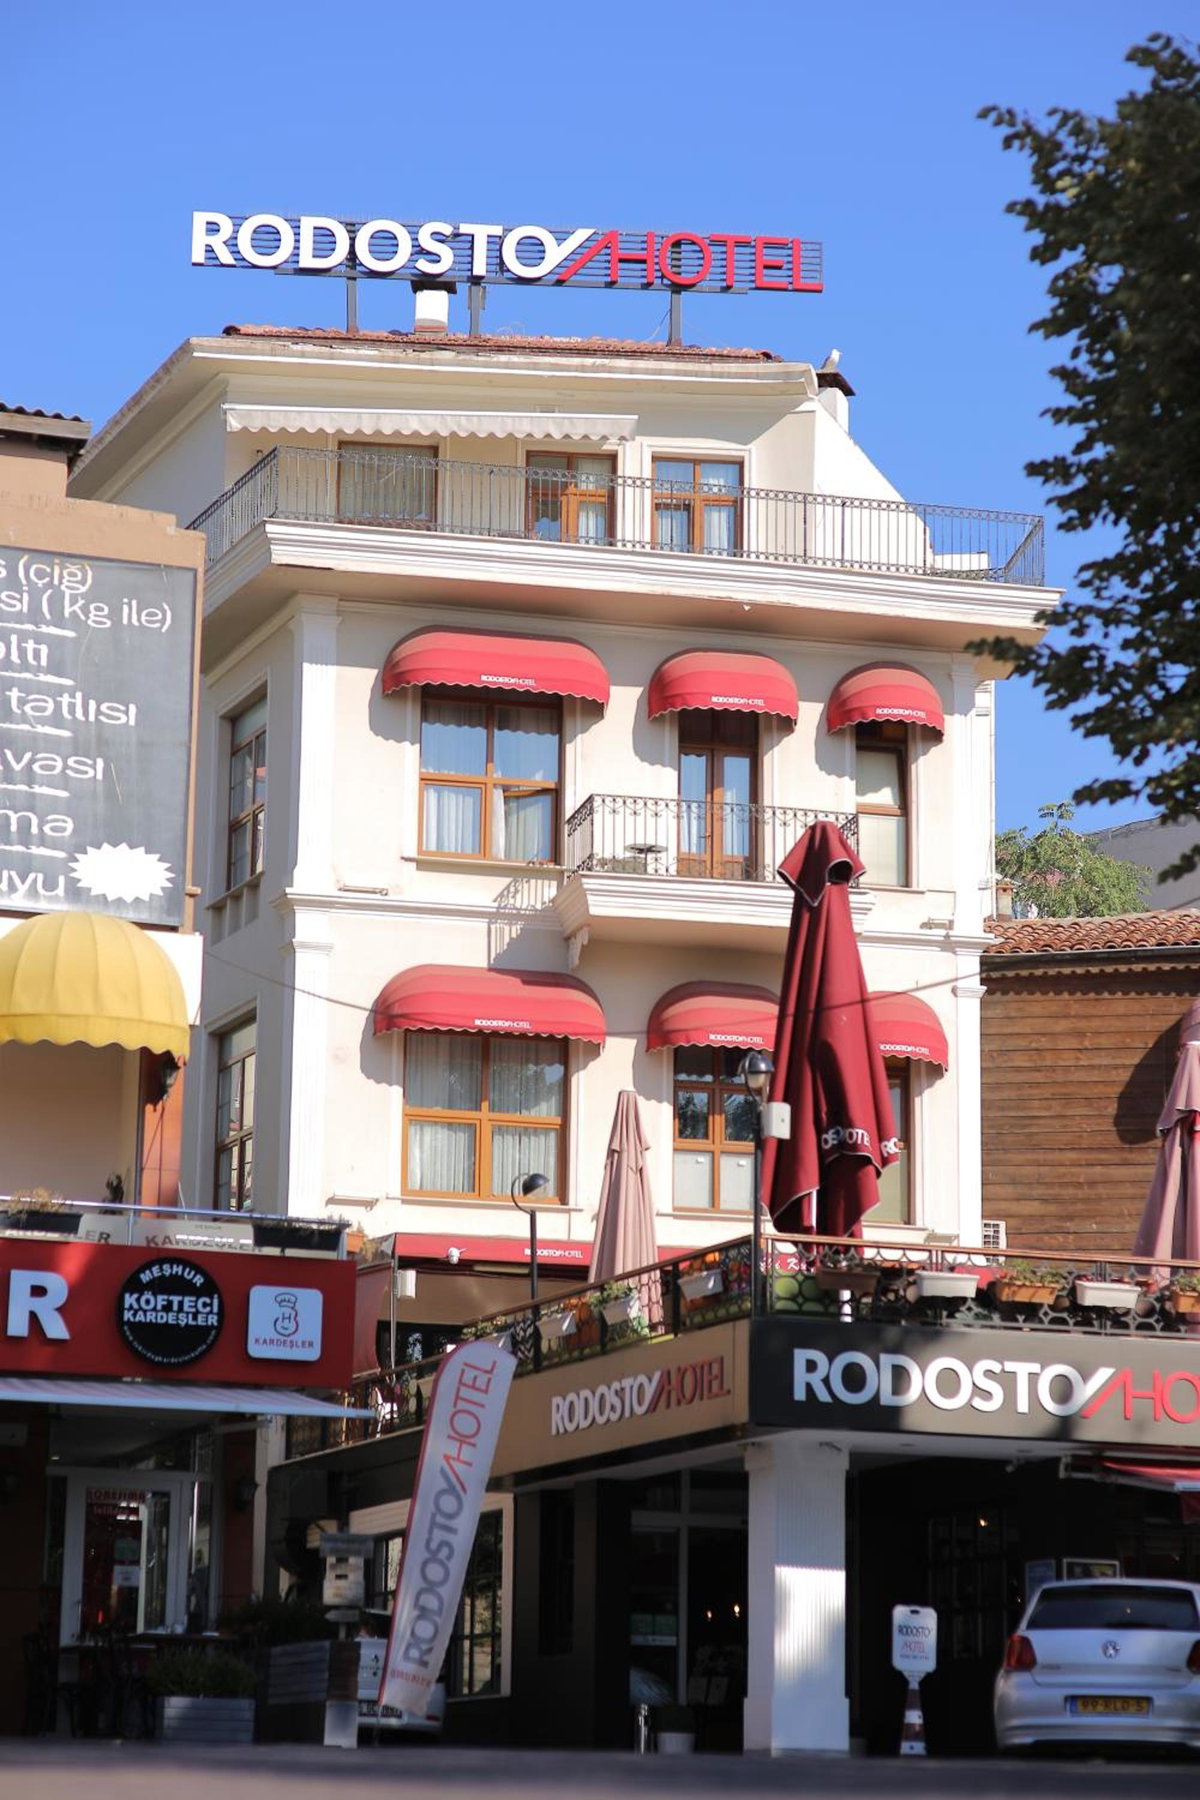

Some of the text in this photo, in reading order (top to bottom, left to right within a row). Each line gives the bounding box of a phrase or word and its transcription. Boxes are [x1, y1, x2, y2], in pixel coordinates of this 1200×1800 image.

[191, 210, 823, 293] RODOSTO HOTEL
[122, 598, 173, 633] ile)
[0, 749, 104, 780] vası
[140, 1263, 204, 1288] MEŞHUR
[7, 1268, 71, 1340] R
[123, 1309, 218, 1328] KARDEŞLER
[124, 1291, 218, 1313] KÖFTECİ
[551, 1355, 731, 1436] RODOSTO HOTEL
[793, 1348, 1116, 1418] RODOSTO
[403, 1466, 465, 1669] RODOSTO
[443, 1360, 497, 1494] HOTEL
